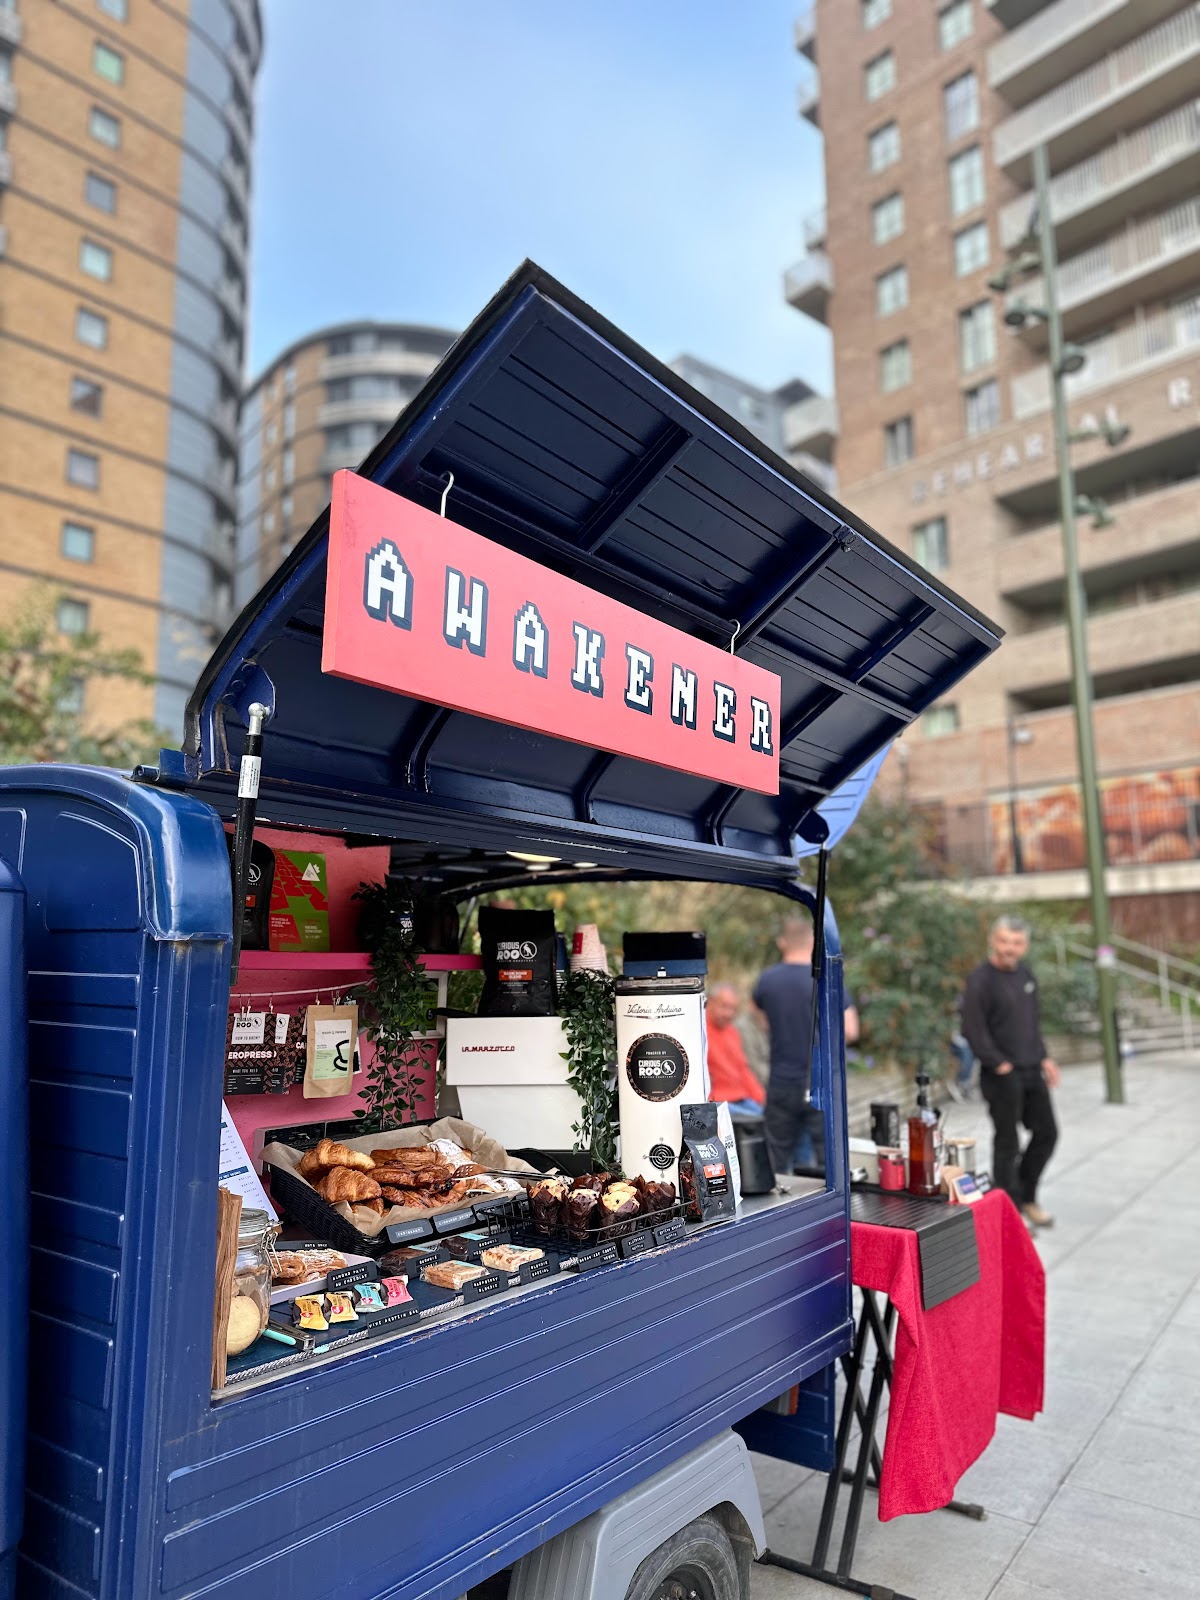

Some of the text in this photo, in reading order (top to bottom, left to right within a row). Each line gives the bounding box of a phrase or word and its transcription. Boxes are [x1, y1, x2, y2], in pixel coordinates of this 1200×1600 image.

[363, 537, 774, 756] AWAKENER
[496, 950, 520, 960] ROO
[628, 1004, 682, 1014] Victoria Arduino
[228, 1050, 272, 1060] EROPRESS
[638, 1067, 661, 1076] ROO
[332, 1271, 350, 1281] ALMOND
[384, 1313, 406, 1323] PROTEIN
